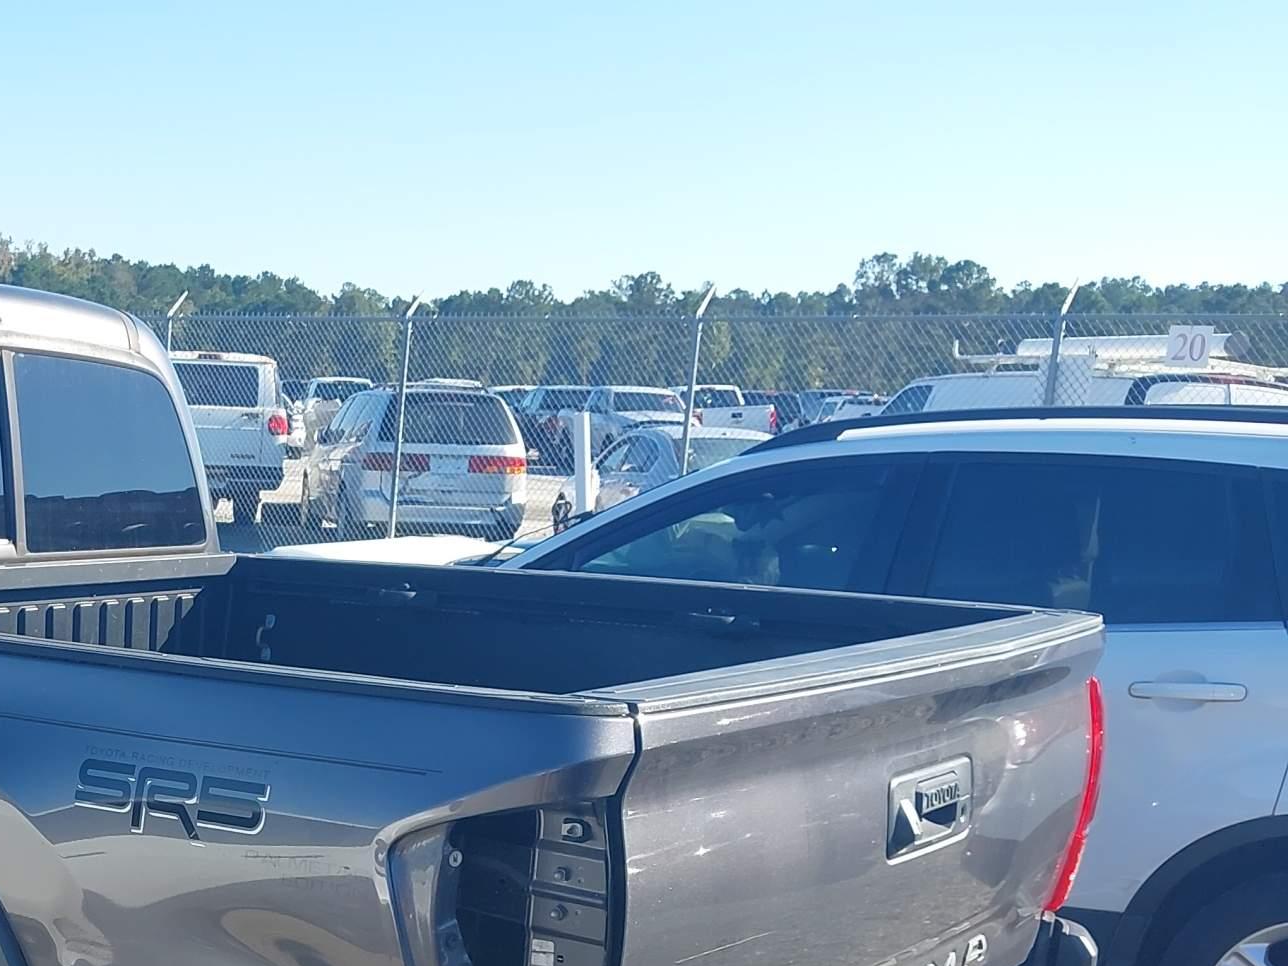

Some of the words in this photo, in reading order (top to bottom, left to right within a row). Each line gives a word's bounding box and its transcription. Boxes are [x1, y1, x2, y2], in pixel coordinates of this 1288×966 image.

[1170, 332, 1206, 362] 20
[83, 743, 127, 760] TOYOTA
[130, 750, 177, 768] RACING
[178, 757, 272, 780] DEVELOPMENT
[74, 758, 272, 847] SR5
[923, 782, 961, 810] TOYOTA
